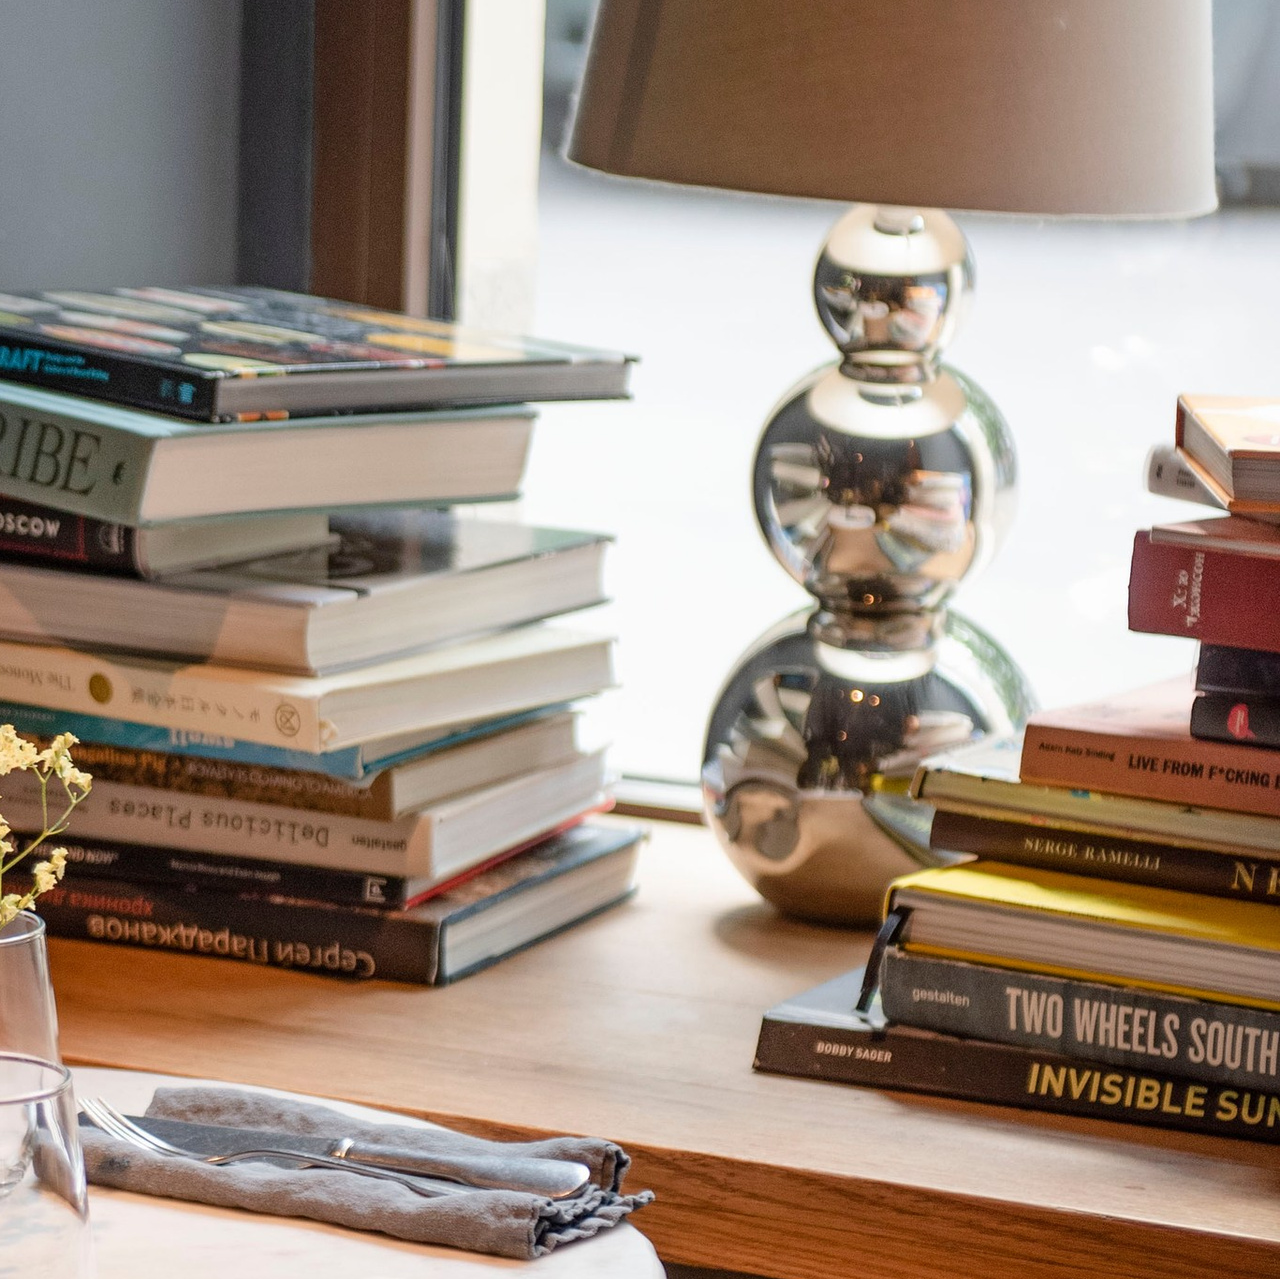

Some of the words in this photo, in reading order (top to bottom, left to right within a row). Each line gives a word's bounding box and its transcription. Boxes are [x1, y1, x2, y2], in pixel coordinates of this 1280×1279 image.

[1128, 754, 1158, 772] LIVE
[1163, 759, 1204, 779] FROM
[109, 798, 191, 830] Places
[203, 810, 329, 847] Delicious
[1023, 837, 1078, 859] SERGE
[1084, 846, 1161, 871] RAMELLI
[87, 914, 269, 964] Параджанов
[276, 941, 376, 977] Сергей
[912, 987, 970, 1007] gestalten
[1005, 987, 1064, 1039] TWO
[1074, 998, 1180, 1059] WHEELS
[1188, 1018, 1280, 1076] SOUTH
[816, 1041, 855, 1057] BOBBY
[855, 1047, 893, 1063] SAGER
[1027, 1063, 1209, 1118] INVISIBLE
